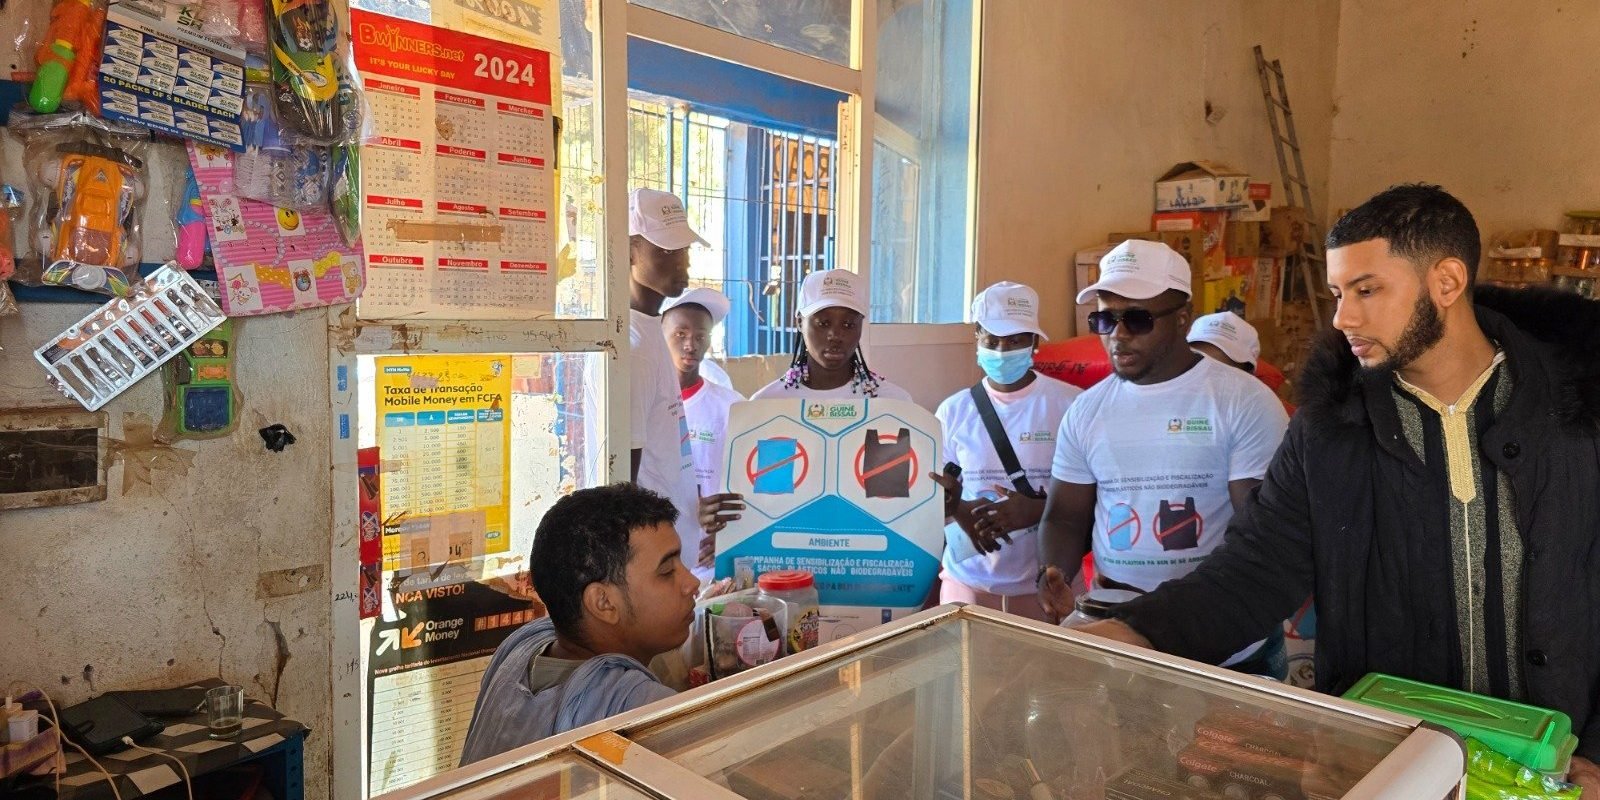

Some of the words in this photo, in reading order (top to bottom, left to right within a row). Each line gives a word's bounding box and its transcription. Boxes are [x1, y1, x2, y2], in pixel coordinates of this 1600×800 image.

[140, 25, 155, 34] FINE
[369, 57, 386, 66] IT'S
[388, 60, 410, 72] YOUR
[412, 64, 438, 75] LUCKY
[440, 69, 456, 80] DAY
[474, 53, 535, 88] 2024
[378, 82, 406, 93] Janeiro
[103, 75, 116, 85] 20
[118, 80, 151, 94] PACKS
[152, 89, 165, 98] OF
[173, 95, 210, 112] BLADES
[211, 107, 235, 119] EACH
[381, 137, 401, 147] Abril
[511, 155, 532, 165] Junho
[384, 197, 406, 206] Julho
[452, 203, 475, 212] Agosto
[382, 256, 414, 265] Outubro
[446, 259, 483, 268] Novembro
[384, 385, 411, 395] Taxa
[413, 386, 427, 394] de
[430, 382, 483, 394] Transação
[384, 395, 421, 406] Mobile
[423, 395, 457, 406] Money
[460, 396, 475, 404] em
[477, 393, 503, 403] FCFA
[829, 404, 856, 413] GUINÉ
[829, 410, 857, 418] BISSAU
[808, 537, 850, 548] AMBIENTE
[785, 556, 795, 565] DE
[796, 557, 855, 568] SENSIBILIZAÇÃO
[856, 559, 861, 567] E
[862, 558, 915, 569] FISCALIZAÇÃO
[830, 566, 846, 575] NÃO
[850, 567, 914, 577] BIODEGRADÁVEIS
[440, 574, 452, 582] de
[426, 583, 465, 599] VISTO!
[425, 616, 464, 631] Orange
[425, 629, 460, 643] Money
[1197, 727, 1233, 743] Colgate
[1179, 756, 1217, 773] Colgate
[1229, 770, 1272, 786] CHARCOAL
